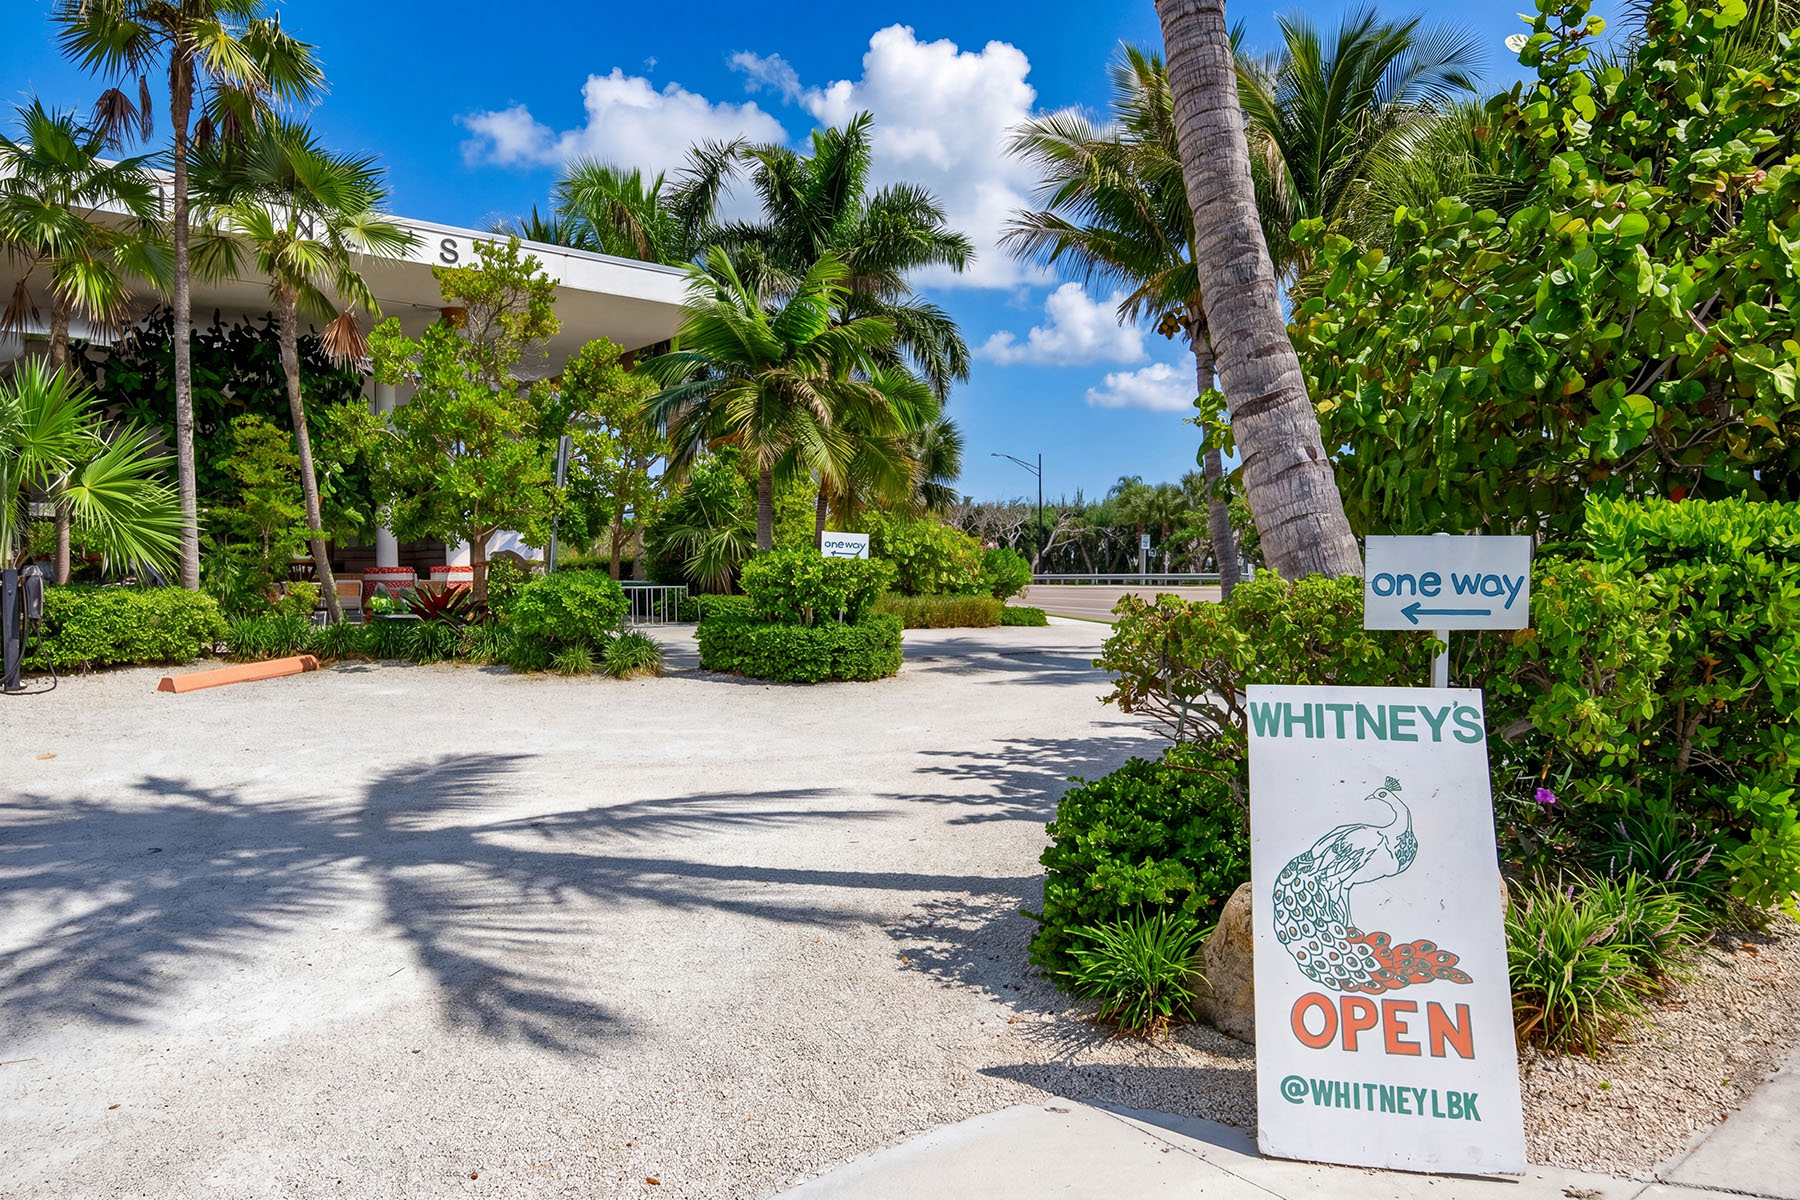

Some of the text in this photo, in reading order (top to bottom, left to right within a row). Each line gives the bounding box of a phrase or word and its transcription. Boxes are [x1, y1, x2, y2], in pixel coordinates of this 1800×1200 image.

[824, 541, 867, 554] one way
[1371, 571, 1525, 610] one way
[1249, 700, 1484, 744] WHITNEY'S
[1290, 991, 1476, 1060] OPEN
[1280, 1074, 1482, 1122] @WHITNEYLBK
